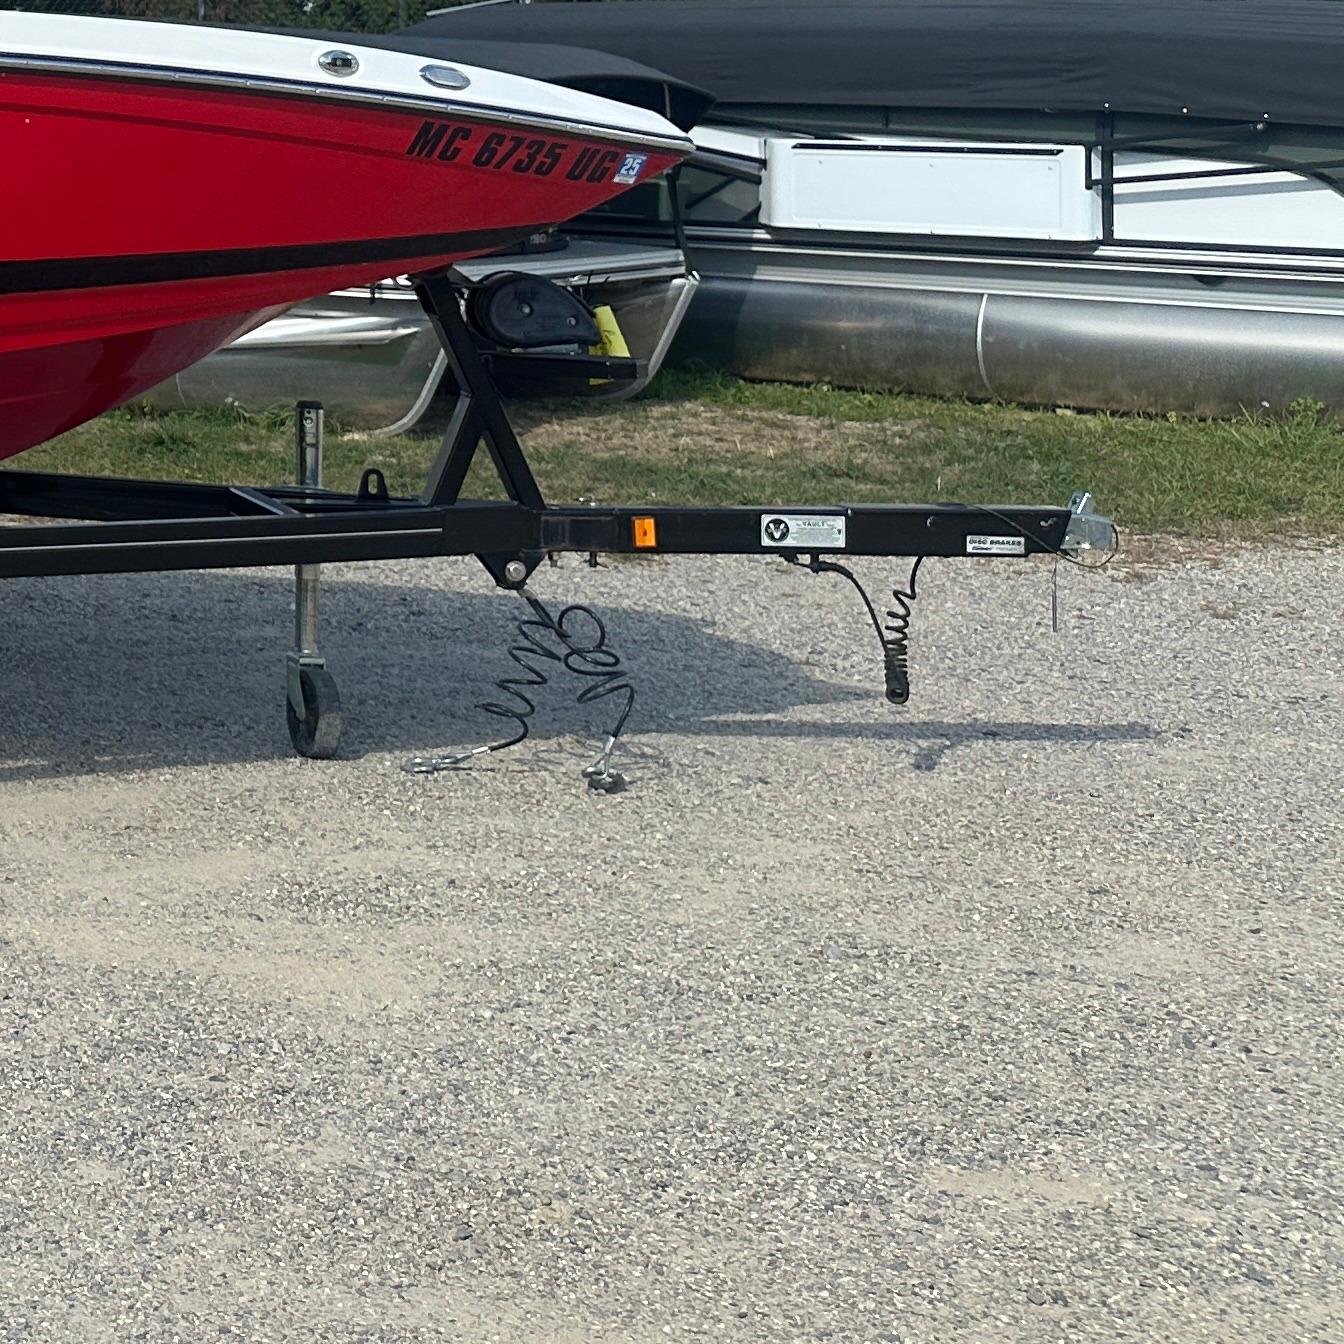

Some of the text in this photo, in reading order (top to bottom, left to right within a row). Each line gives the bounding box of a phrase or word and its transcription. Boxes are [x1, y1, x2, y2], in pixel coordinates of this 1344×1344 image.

[406, 120, 472, 162] MC
[472, 131, 568, 177] 6735
[620, 157, 643, 175] 25
